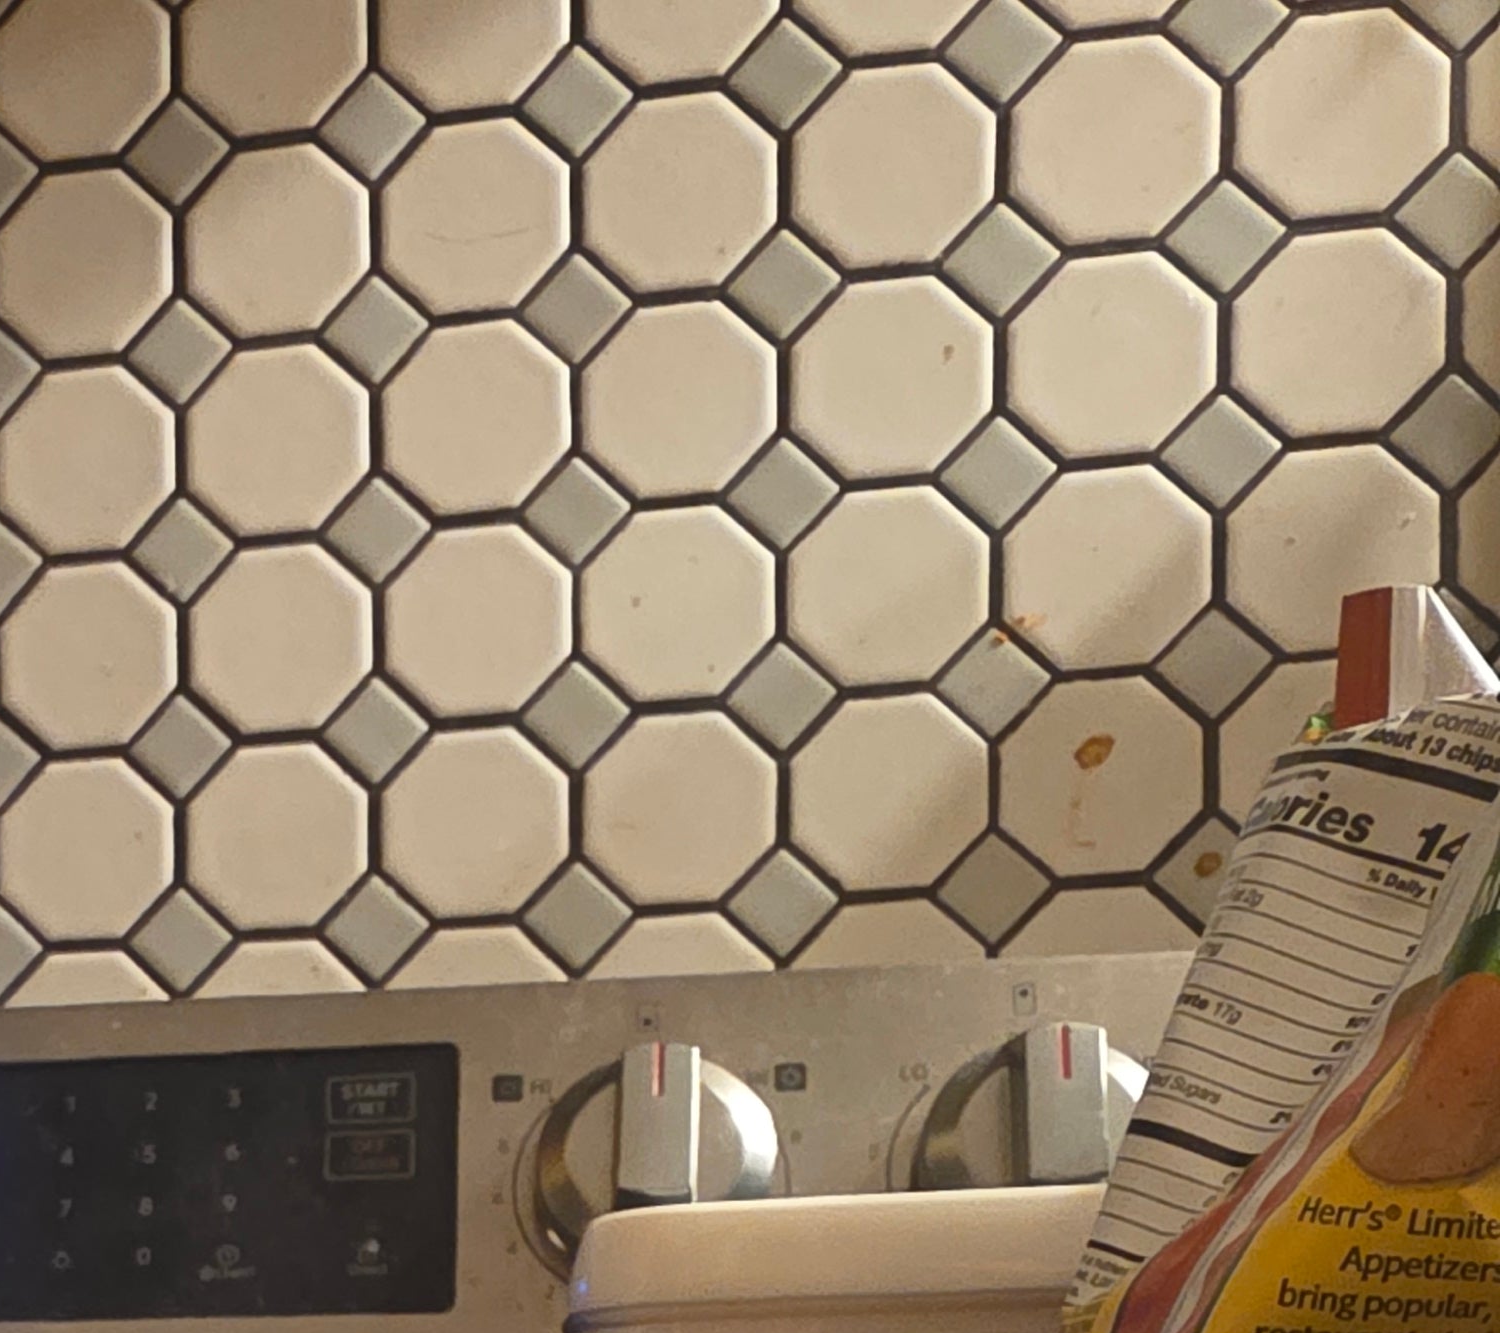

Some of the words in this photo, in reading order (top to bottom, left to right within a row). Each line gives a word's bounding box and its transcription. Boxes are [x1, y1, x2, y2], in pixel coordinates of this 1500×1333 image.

[1419, 734, 1448, 757] 13
[1383, 872, 1427, 898] Daily
[1168, 1075, 1223, 1106] Sugars
[1276, 1277, 1359, 1321] bring
[1362, 1291, 1494, 1324] popular,
